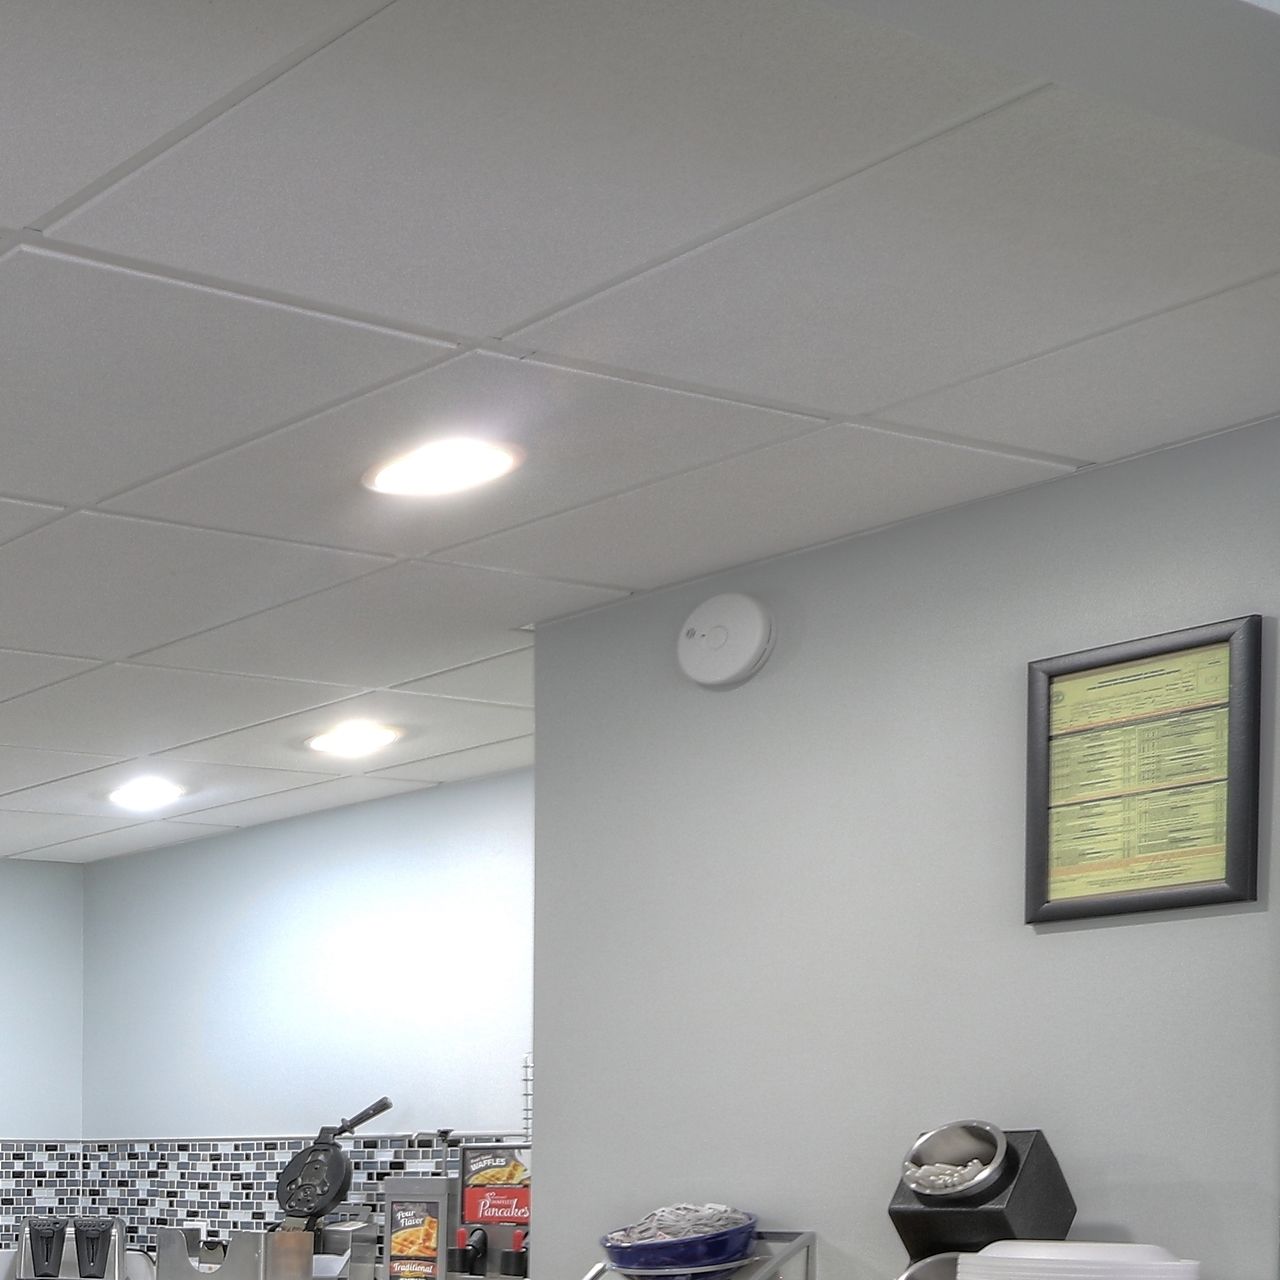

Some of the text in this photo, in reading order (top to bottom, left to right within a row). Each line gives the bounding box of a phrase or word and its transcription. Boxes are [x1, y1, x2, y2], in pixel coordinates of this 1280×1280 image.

[470, 1158, 506, 1171] WAFFLES
[479, 1198, 530, 1218] Pancakes
[393, 1262, 433, 1273] Traditional
